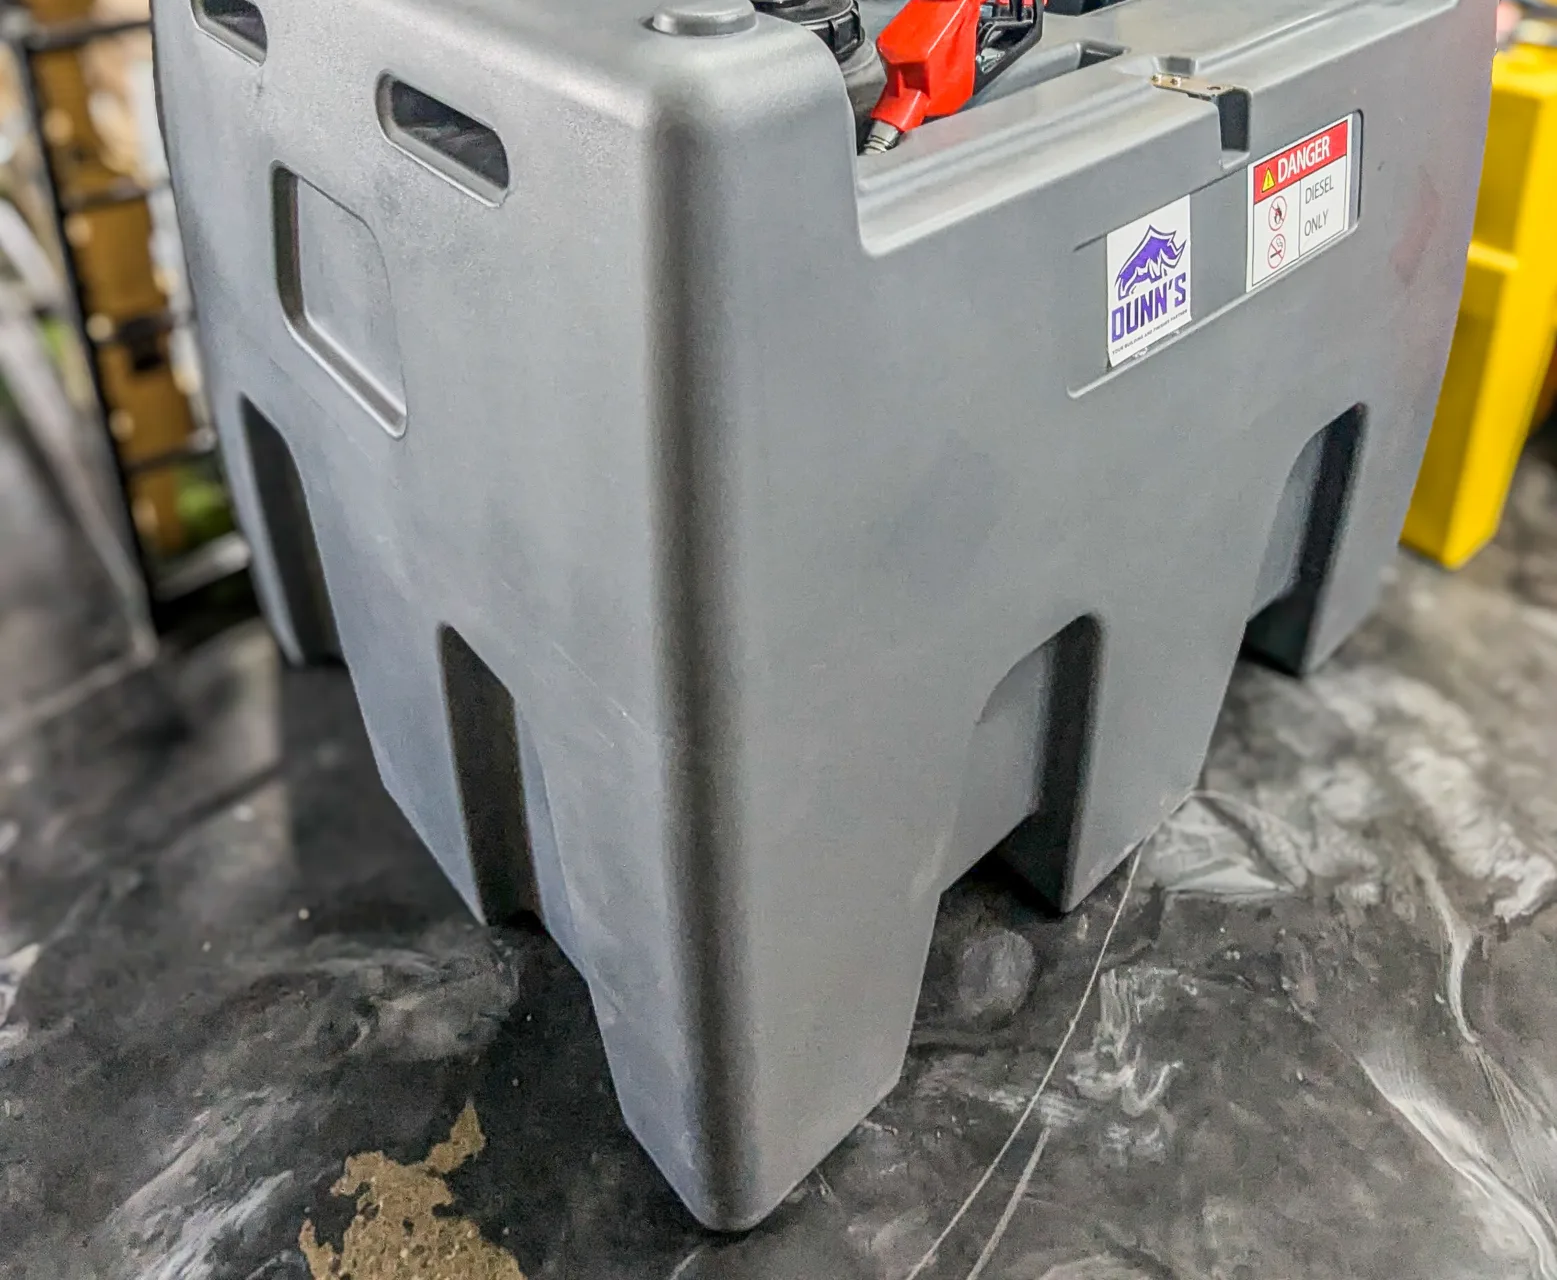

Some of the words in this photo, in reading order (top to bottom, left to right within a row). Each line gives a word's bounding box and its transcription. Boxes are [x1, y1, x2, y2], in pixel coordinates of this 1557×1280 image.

[1277, 135, 1331, 184] DANGER
[1305, 174, 1334, 205] DIESEL
[1304, 208, 1330, 237] ONLY
[1111, 272, 1186, 343] DUNN'S
[1112, 346, 1124, 355] YOUR
[1124, 335, 1144, 349] BUILDING
[1144, 329, 1153, 338] AND
